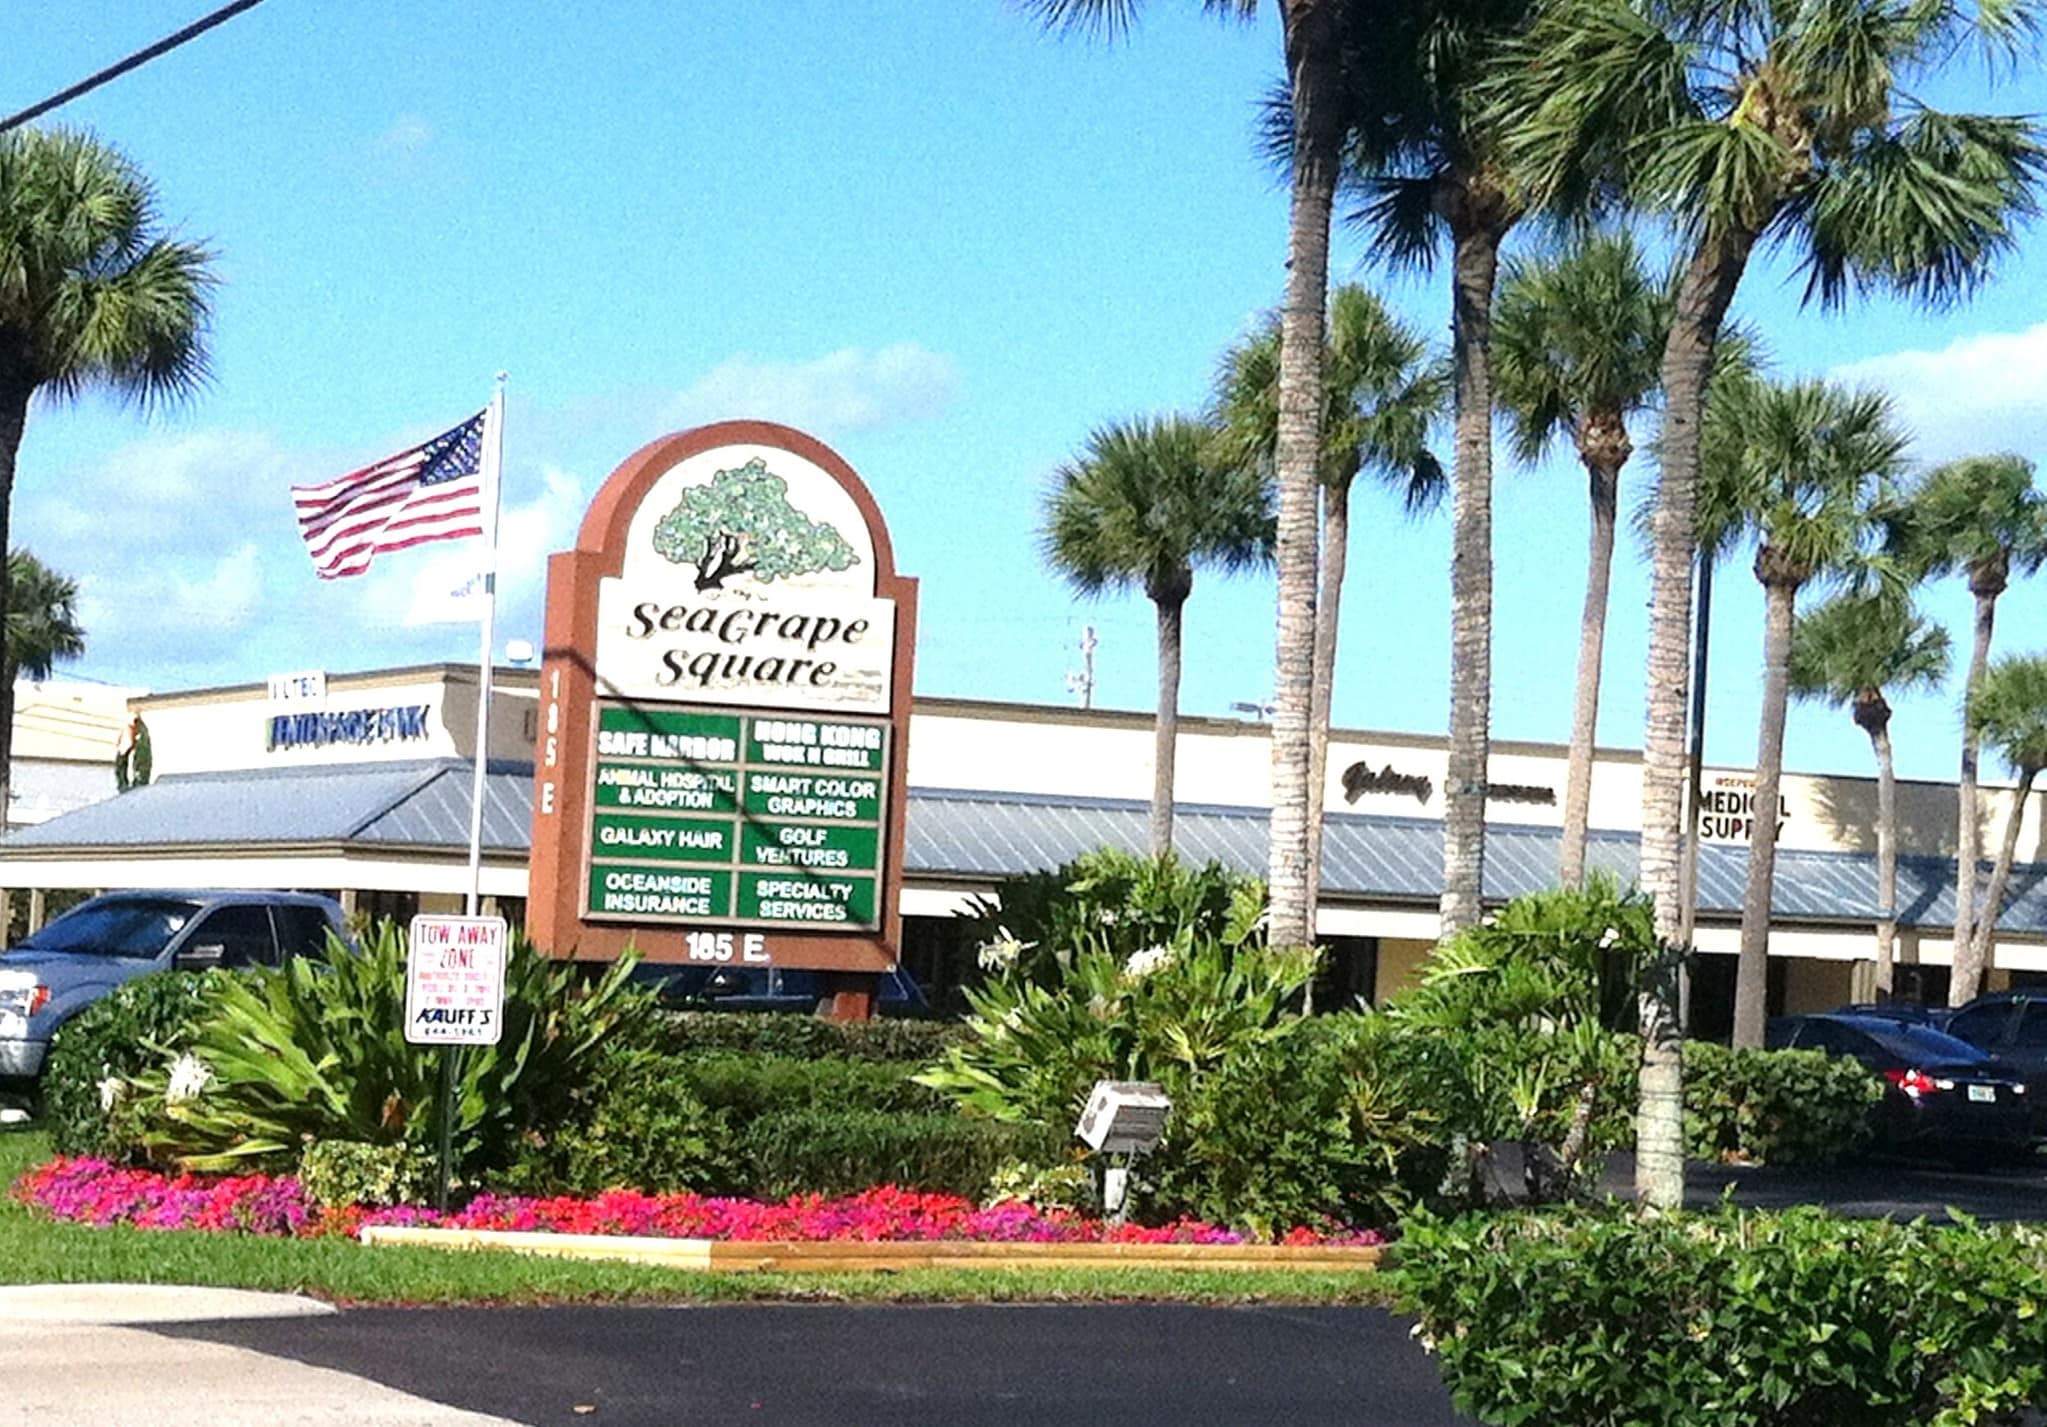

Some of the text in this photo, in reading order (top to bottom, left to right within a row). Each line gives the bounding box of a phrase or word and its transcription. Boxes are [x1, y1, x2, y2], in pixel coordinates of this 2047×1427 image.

[656, 648, 837, 687] Square
[598, 731, 648, 756] SAFE
[754, 720, 881, 750] HONG KONG
[598, 768, 658, 787] ANIMAL
[750, 775, 877, 799] SMART COLOR
[633, 788, 713, 808] ADOPTION
[767, 796, 857, 817] GRAPHICS
[1698, 790, 1791, 818] MEDIL
[600, 826, 723, 849] GALAXY HAIR
[779, 827, 828, 846] GOLF
[1700, 816, 1785, 842] SUPPY
[755, 846, 848, 867] VENTURES
[605, 873, 712, 894] OCEANSIDE
[756, 880, 853, 901] SPECIALTY
[604, 893, 711, 914] INSURANCE
[759, 900, 847, 920] SERVICES
[421, 924, 497, 945] TOW AWAY
[743, 933, 770, 962] E
[440, 948, 474, 969] ZONE
